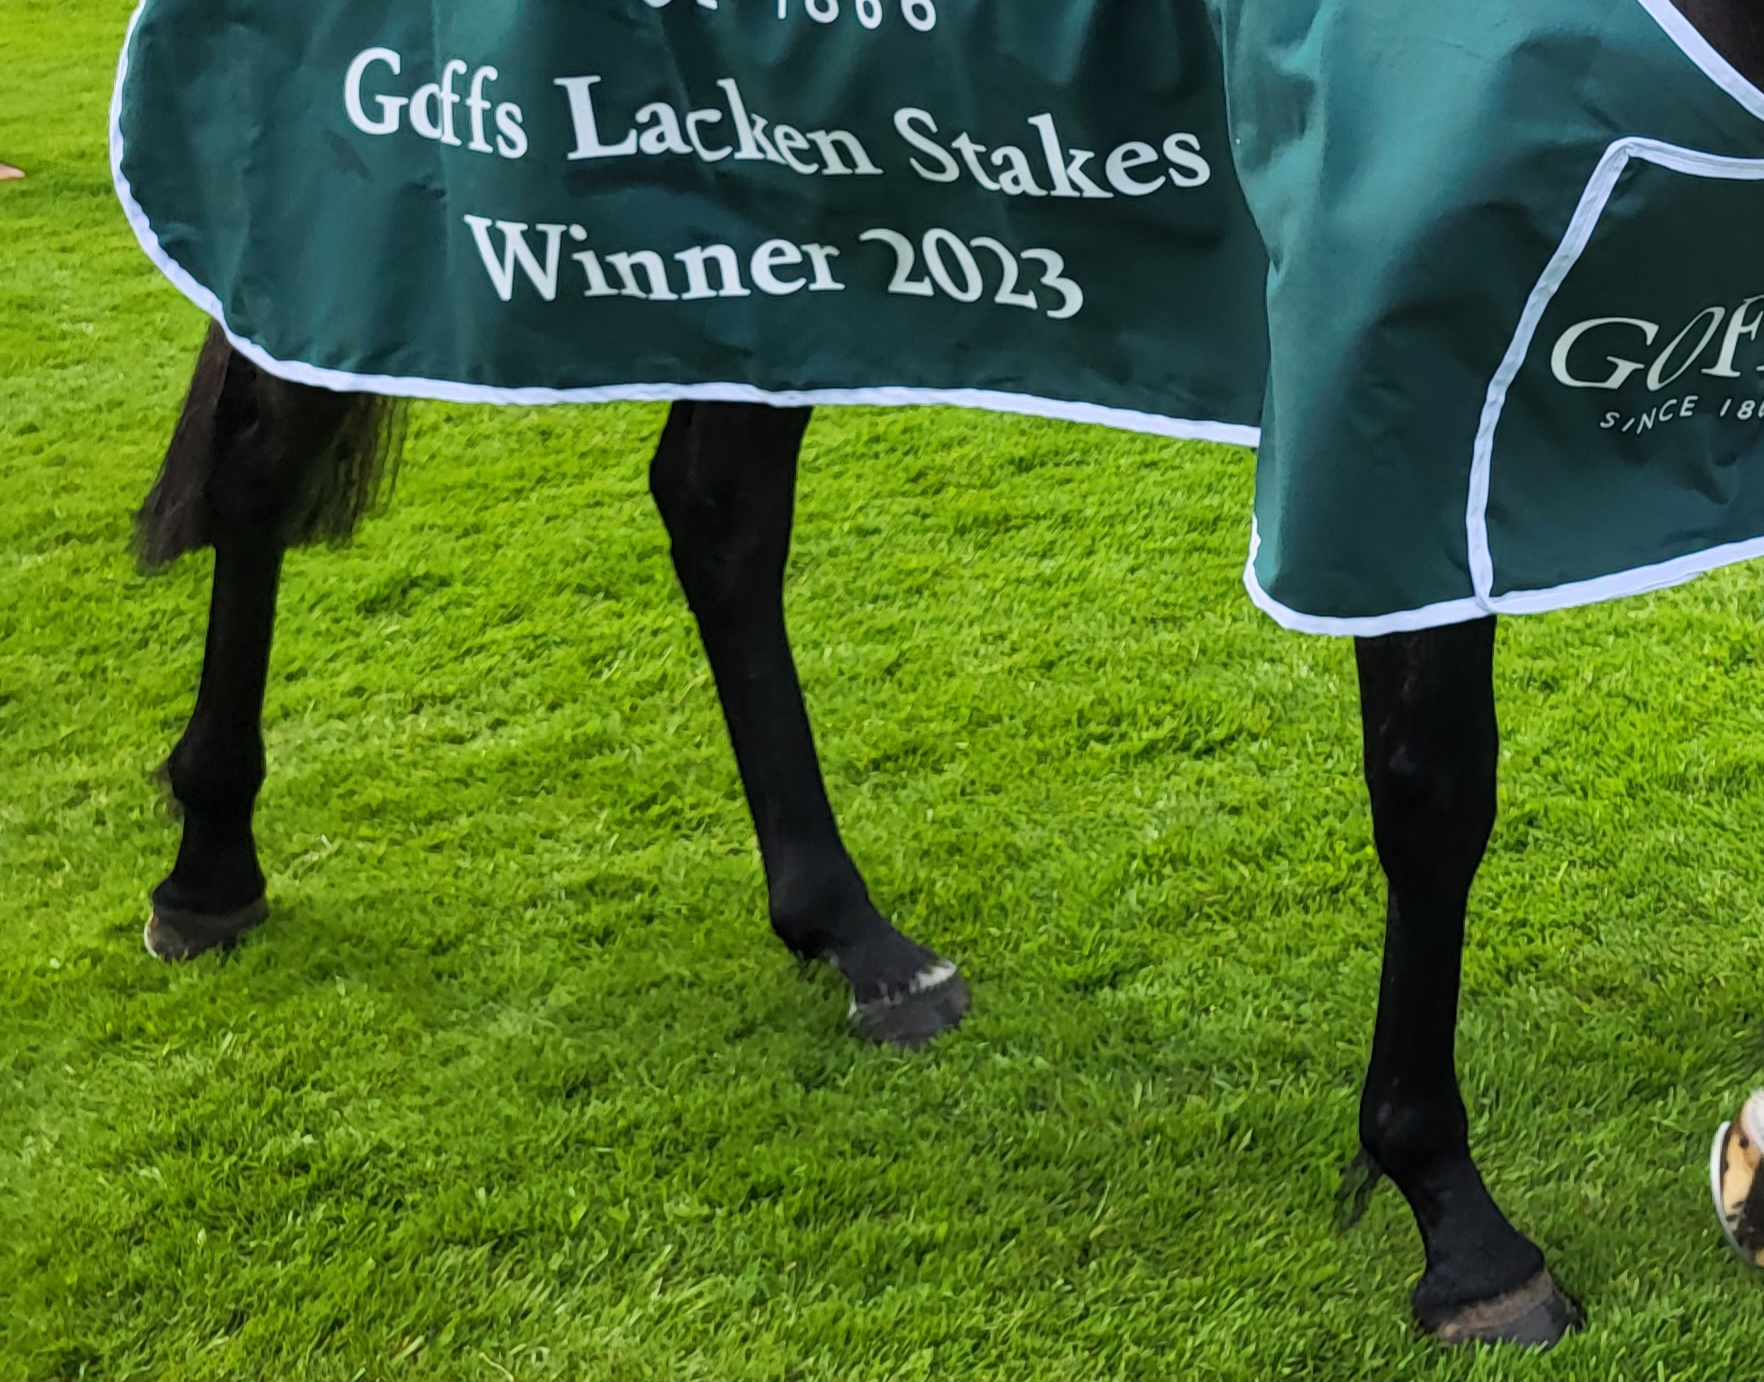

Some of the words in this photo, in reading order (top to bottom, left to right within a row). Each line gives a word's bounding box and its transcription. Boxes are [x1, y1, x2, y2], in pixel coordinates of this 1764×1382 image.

[344, 47, 529, 159] Goffs
[554, 75, 883, 175] Lacken
[894, 107, 1211, 198] Stakes
[463, 214, 845, 301] Winner
[860, 228, 1084, 319] 2023
[1600, 395, 1699, 434] SINCE
